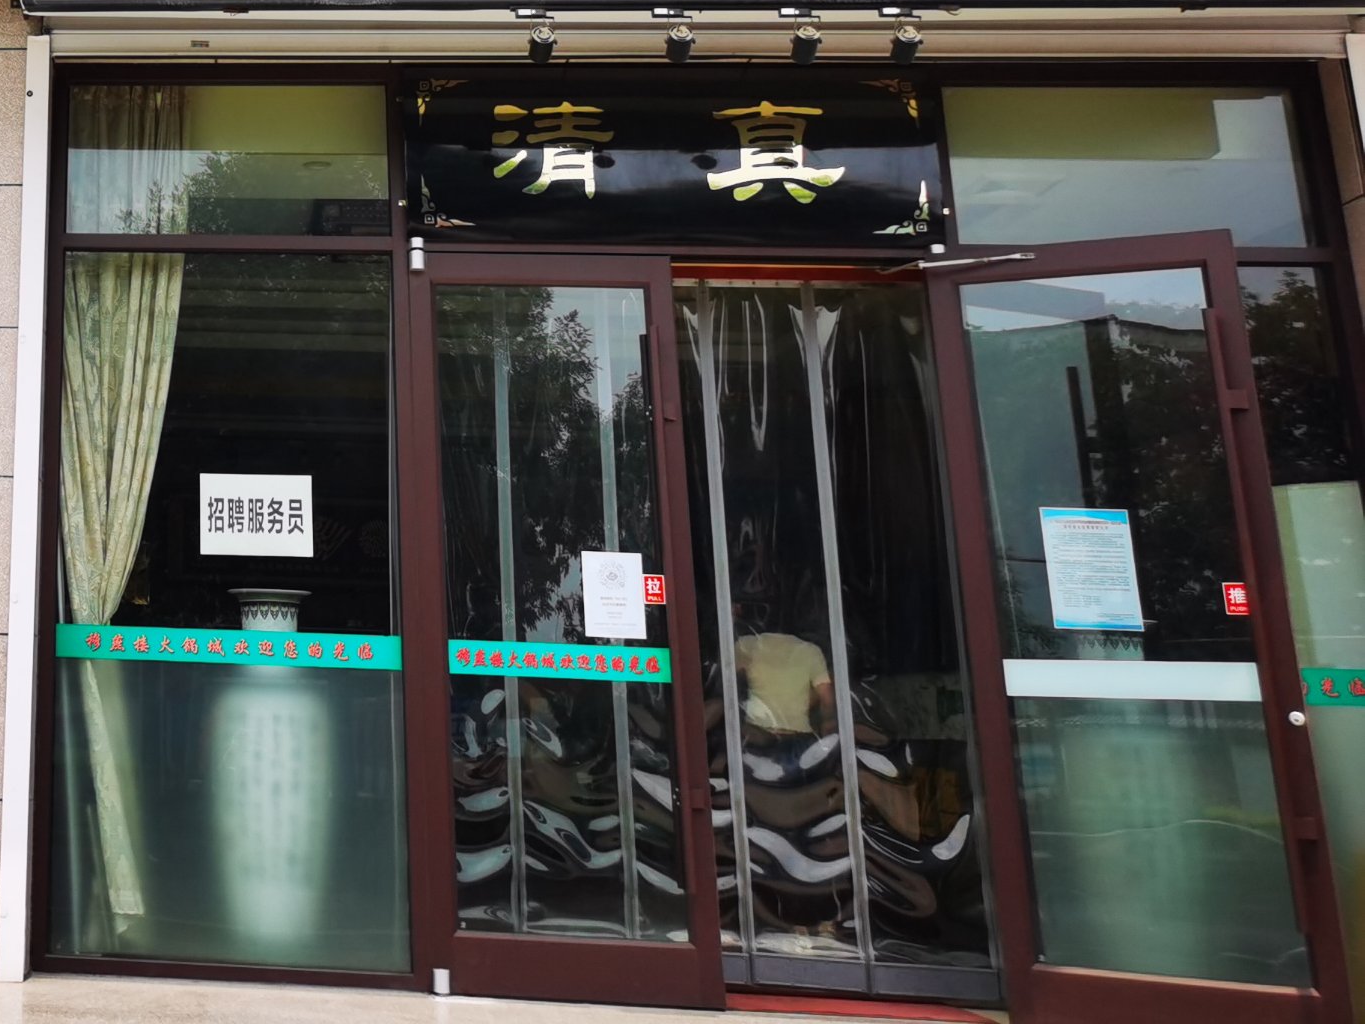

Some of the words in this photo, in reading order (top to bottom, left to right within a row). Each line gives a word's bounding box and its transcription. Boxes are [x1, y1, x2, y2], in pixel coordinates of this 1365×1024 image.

[491, 100, 846, 204] 清真
[207, 496, 304, 535] 招聘服务员
[646, 577, 662, 595] 拉
[1227, 587, 1248, 604] 推
[84, 632, 374, 662] 穆燕楼火锅城欢迎您的光临
